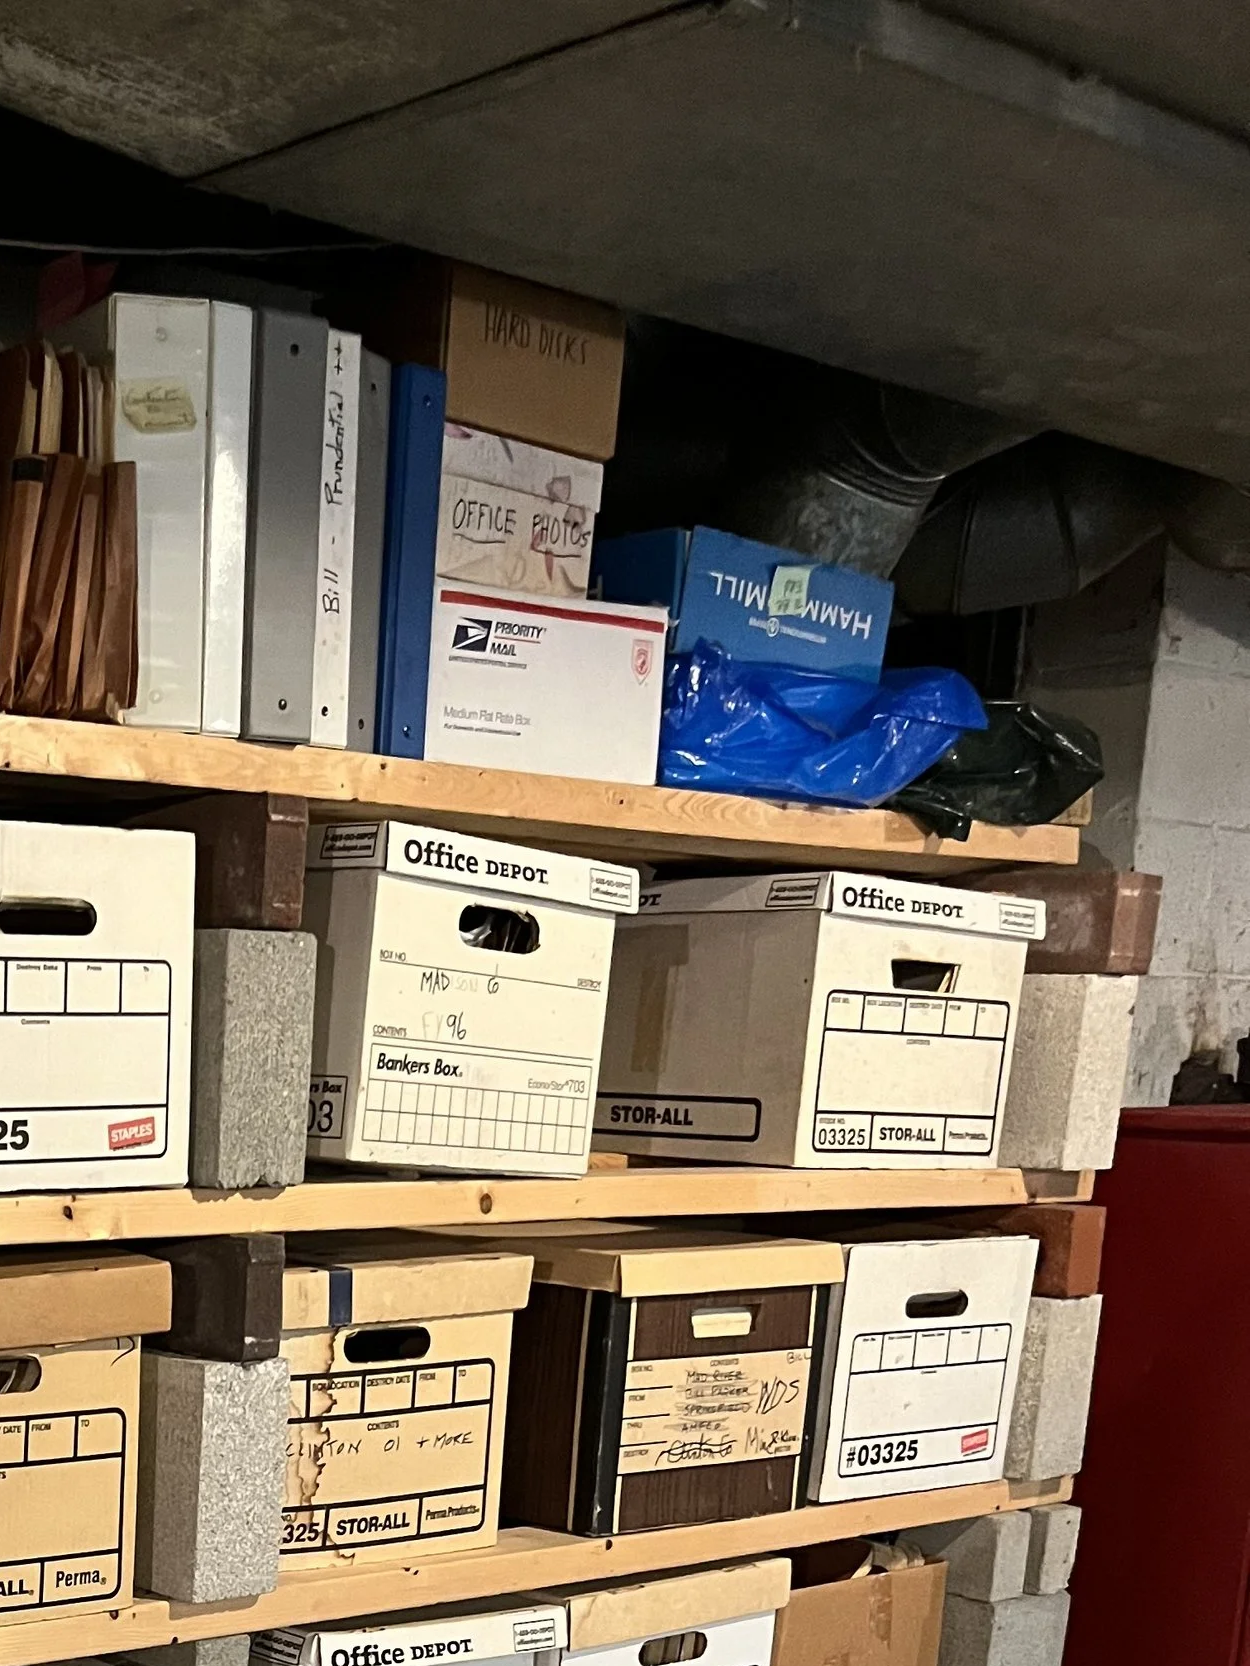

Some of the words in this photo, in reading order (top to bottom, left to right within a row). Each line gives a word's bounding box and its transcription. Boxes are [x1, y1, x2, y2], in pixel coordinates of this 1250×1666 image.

[484, 303, 530, 349] HARD
[538, 323, 587, 365] DISKS
[453, 499, 517, 535] OFFICE
[532, 514, 590, 548] PHOTOS
[323, 568, 339, 614] Bill
[709, 571, 872, 640] HAMMMILL
[495, 622, 543, 639] PRIORITY
[490, 643, 516, 656] MAIL
[444, 706, 478, 720] Medium
[515, 714, 531, 725] Box
[404, 839, 478, 873] Office
[485, 860, 548, 884] DEPOT
[842, 887, 904, 912] Office
[911, 900, 963, 917] DEPOT
[446, 1012, 466, 1040] 96
[377, 1052, 429, 1075] Bankers
[434, 1059, 459, 1076] Box
[611, 1104, 693, 1125] STOR-ALL
[111, 1125, 152, 1142] STAPLES
[818, 1128, 865, 1145] 03325
[879, 1127, 936, 1142] STOR-ALL
[756, 1376, 800, 1415] WDS
[433, 1432, 475, 1449] MORE
[847, 1440, 918, 1468] #03325
[282, 1522, 319, 1544] 325
[336, 1512, 410, 1535] STOR-ALL
[55, 1570, 100, 1588] Perma
[411, 1639, 473, 1660] DEPOT
